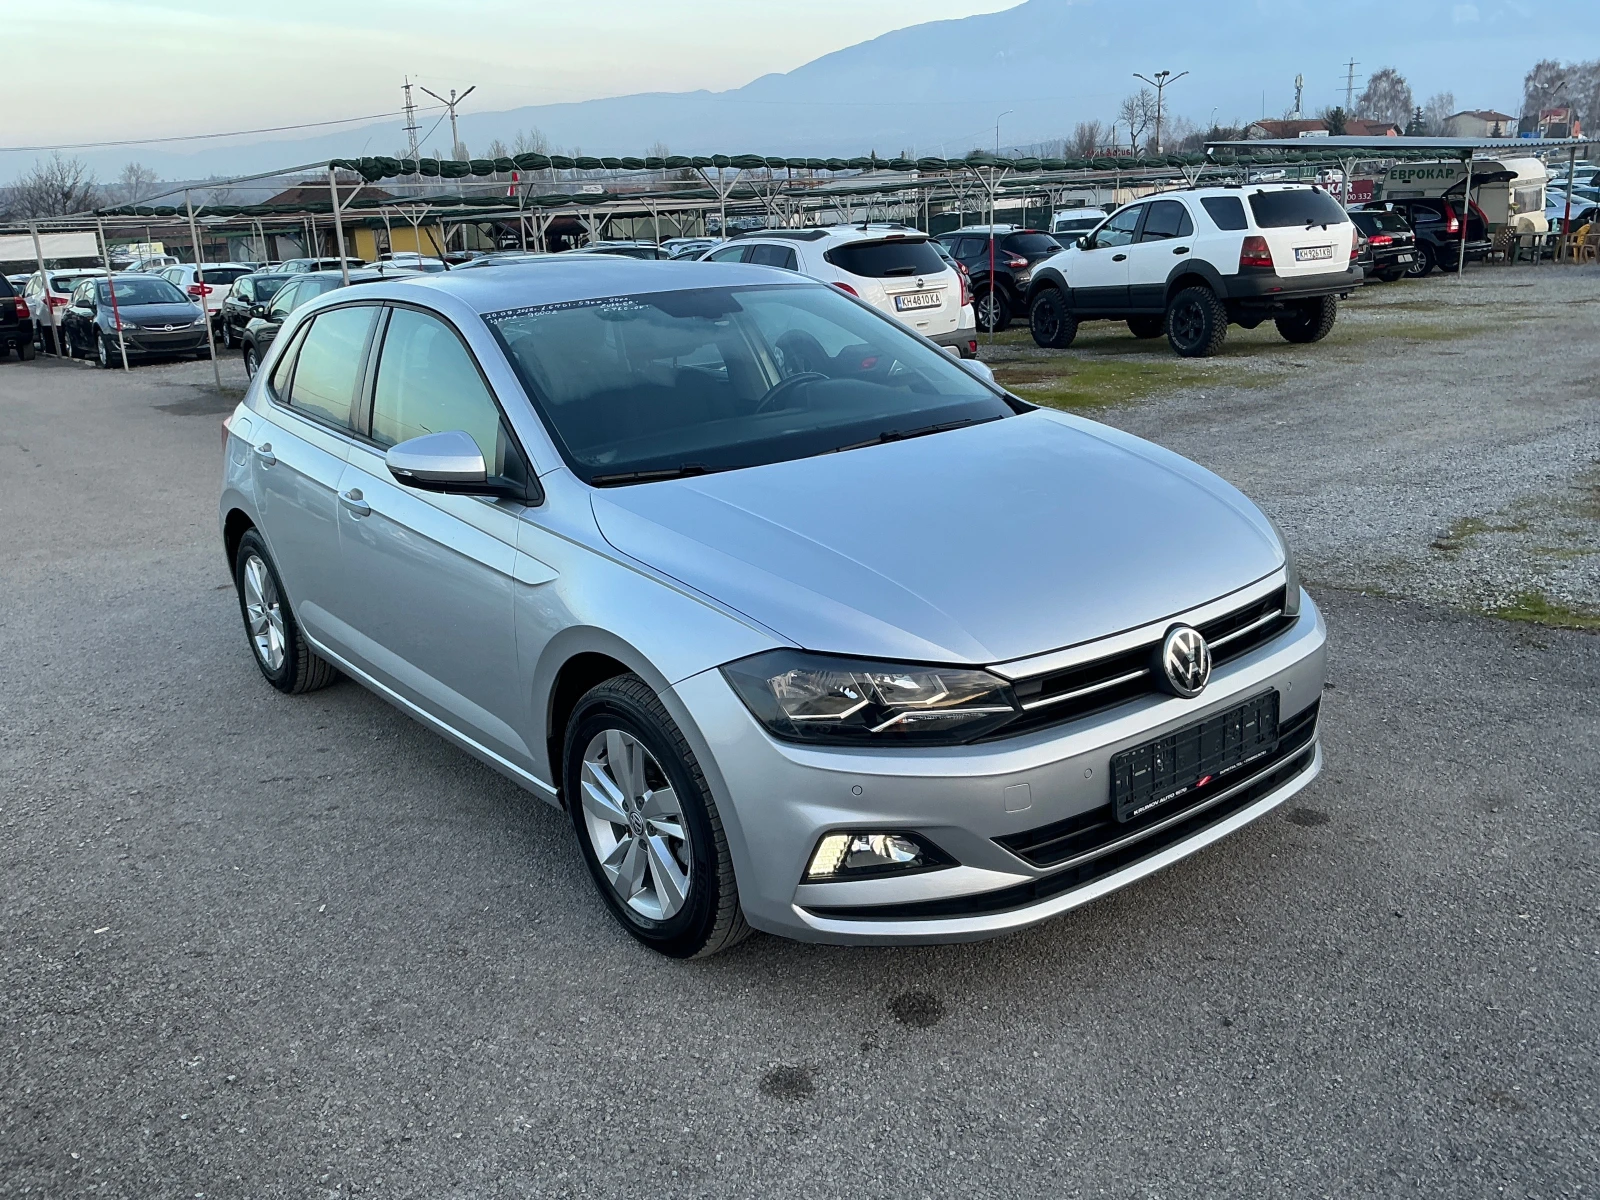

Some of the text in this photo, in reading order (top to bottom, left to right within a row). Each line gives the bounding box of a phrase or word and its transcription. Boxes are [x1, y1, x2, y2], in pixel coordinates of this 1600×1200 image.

[1390, 168, 1455, 180] ЕВРОКАР
[1357, 192, 1372, 200] 332
[901, 294, 941, 307] KH4810KA
[1133, 800, 1159, 815] KRUMOV
[1159, 792, 1175, 804] AUTO
